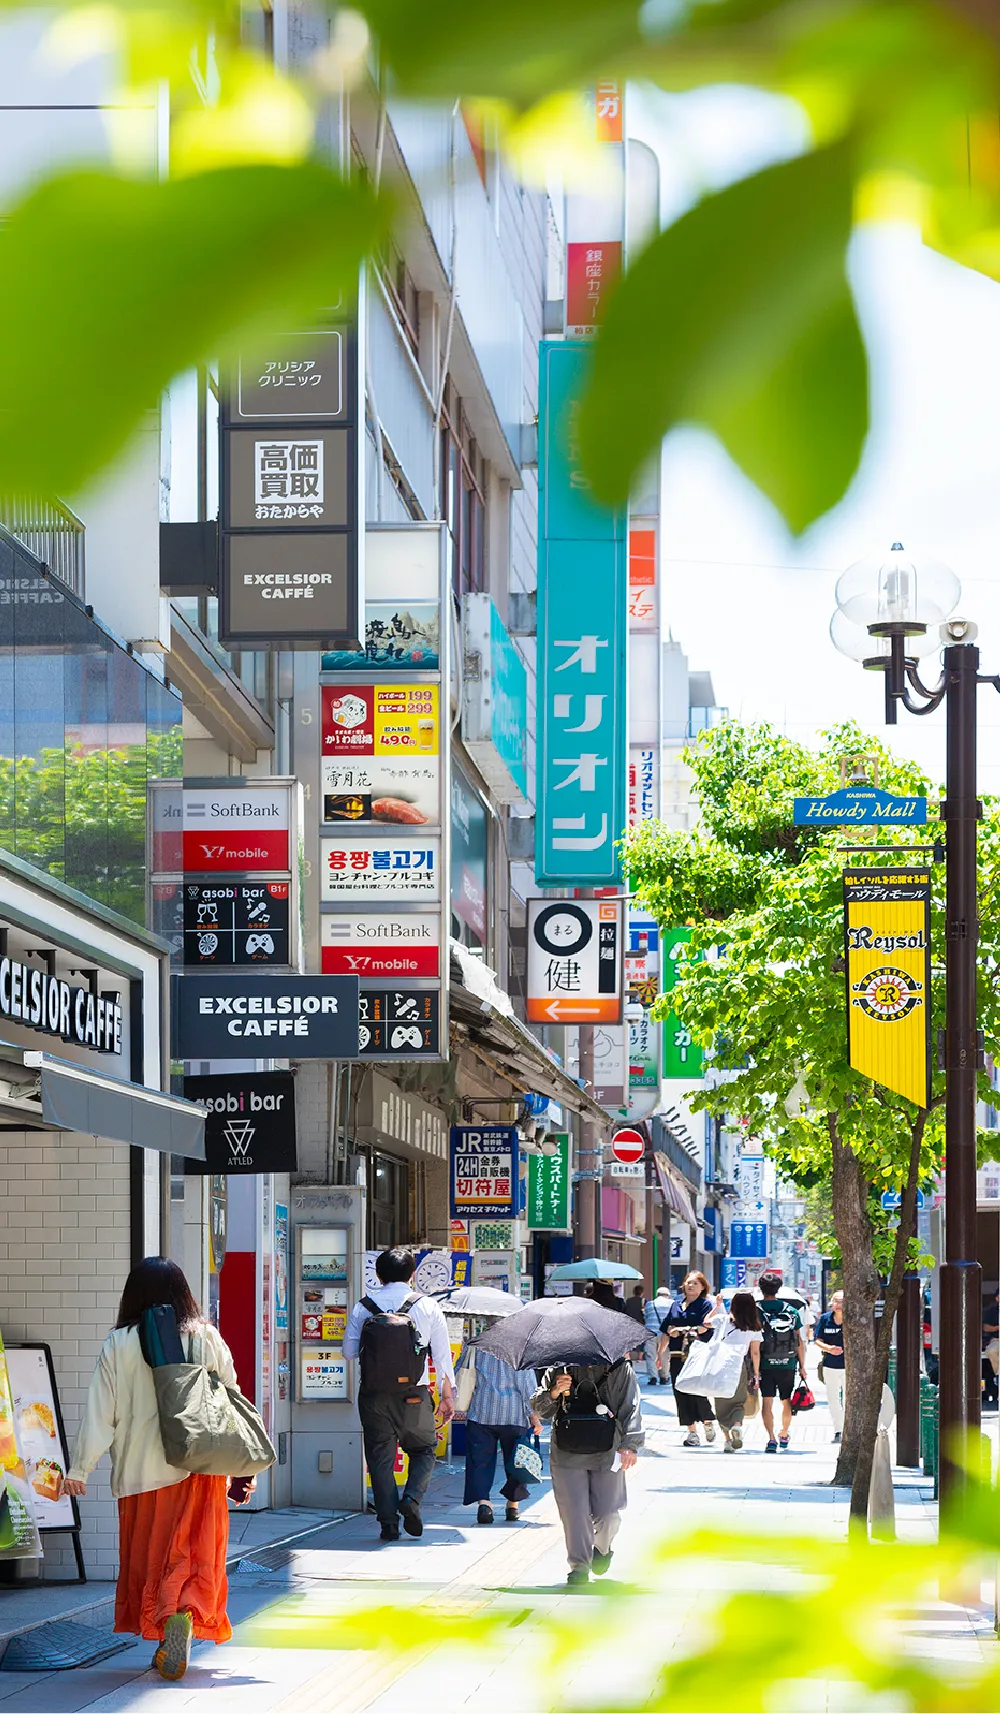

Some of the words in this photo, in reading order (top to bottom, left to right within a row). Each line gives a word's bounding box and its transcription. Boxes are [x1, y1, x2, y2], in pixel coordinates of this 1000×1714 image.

[586, 249, 603, 318] 銀座カラー
[264, 360, 316, 373] アリシア
[258, 373, 322, 387] クリニック
[259, 444, 319, 471] 高価
[259, 473, 320, 499] 買取
[254, 504, 324, 519] おたからや
[243, 573, 333, 585] EXCELSIOR
[261, 584, 314, 599] CAFFÉ
[407, 690, 433, 701] 199
[301, 708, 313, 725] 5
[407, 702, 433, 714] 299
[552, 635, 609, 851] オリオン
[326, 770, 373, 788] 雪月花
[210, 802, 280, 818] SoftBank
[805, 801, 867, 820] Howdy
[871, 801, 917, 818] Mall
[202, 887, 238, 898] asobi
[242, 887, 264, 898] bar
[356, 922, 431, 937] SoftBank
[553, 925, 573, 935] まる
[847, 926, 927, 954] Reysol
[543, 957, 582, 992] 健
[863, 967, 912, 986] KASHIWA
[199, 996, 339, 1015] EXCELSIOR
[864, 1005, 911, 1021] REYSOL
[75, 988, 122, 1055] CAFFÉ
[227, 1015, 309, 1036] CAFFÉ
[250, 1091, 284, 1112] bar
[456, 1132, 482, 1153] JR
[458, 1157, 478, 1176] 24H
[480, 1155, 501, 1166] 金券
[480, 1167, 510, 1177] 自販機
[456, 1179, 511, 1196] 切符屋
